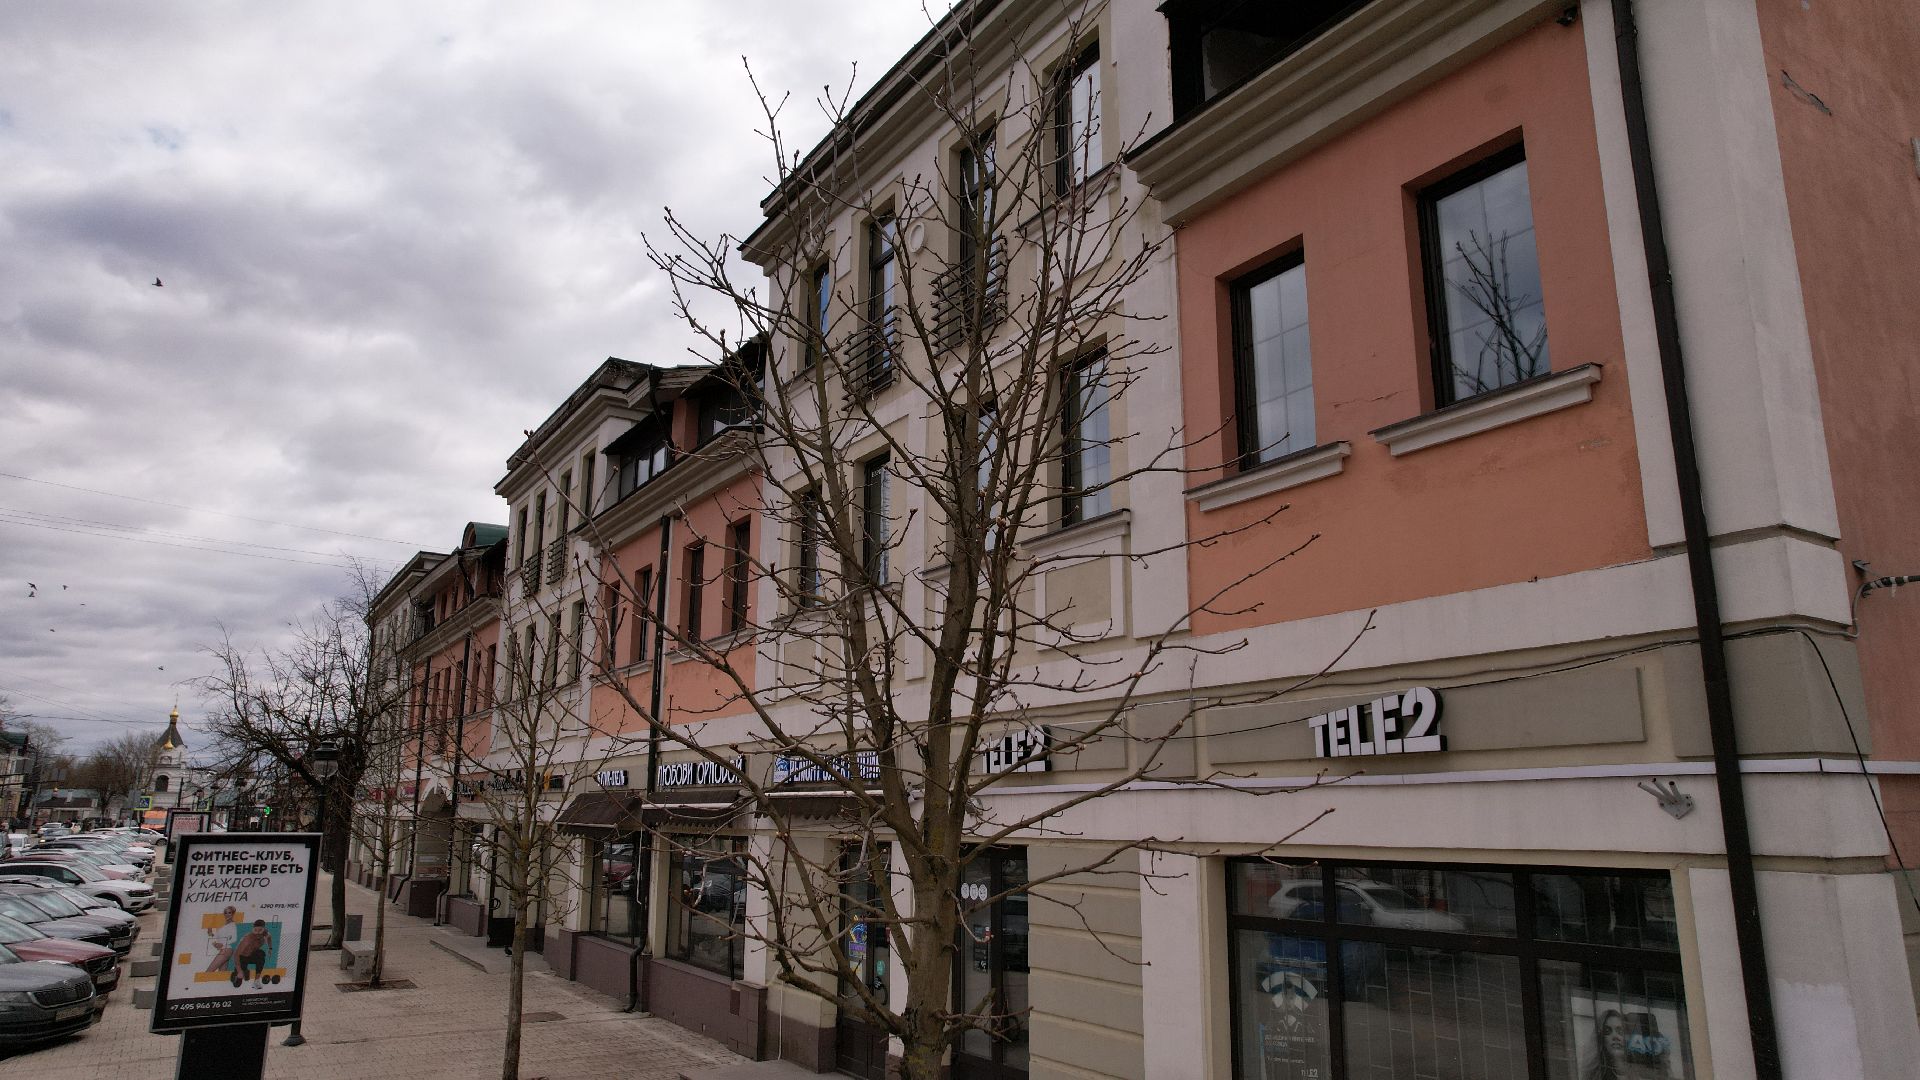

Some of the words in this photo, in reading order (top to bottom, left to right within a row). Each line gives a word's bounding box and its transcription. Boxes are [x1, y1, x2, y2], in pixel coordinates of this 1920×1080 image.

[1308, 686, 1442, 758] TELE2
[976, 724, 1047, 774] TELE2
[657, 762, 693, 786] ЛЮБОВИ
[191, 850, 295, 863] ФИТНЕС-КЛУБ,
[189, 864, 214, 877] ГДЕ
[218, 864, 267, 875] ТРЕНЕР
[270, 863, 304, 874] ЕСТЬ
[188, 878, 198, 889] У
[200, 877, 271, 889] КАЖДОГО
[185, 891, 249, 903] КЛИЕНТА
[170, 1003, 179, 1011] +7
[180, 1003, 195, 1011] 495
